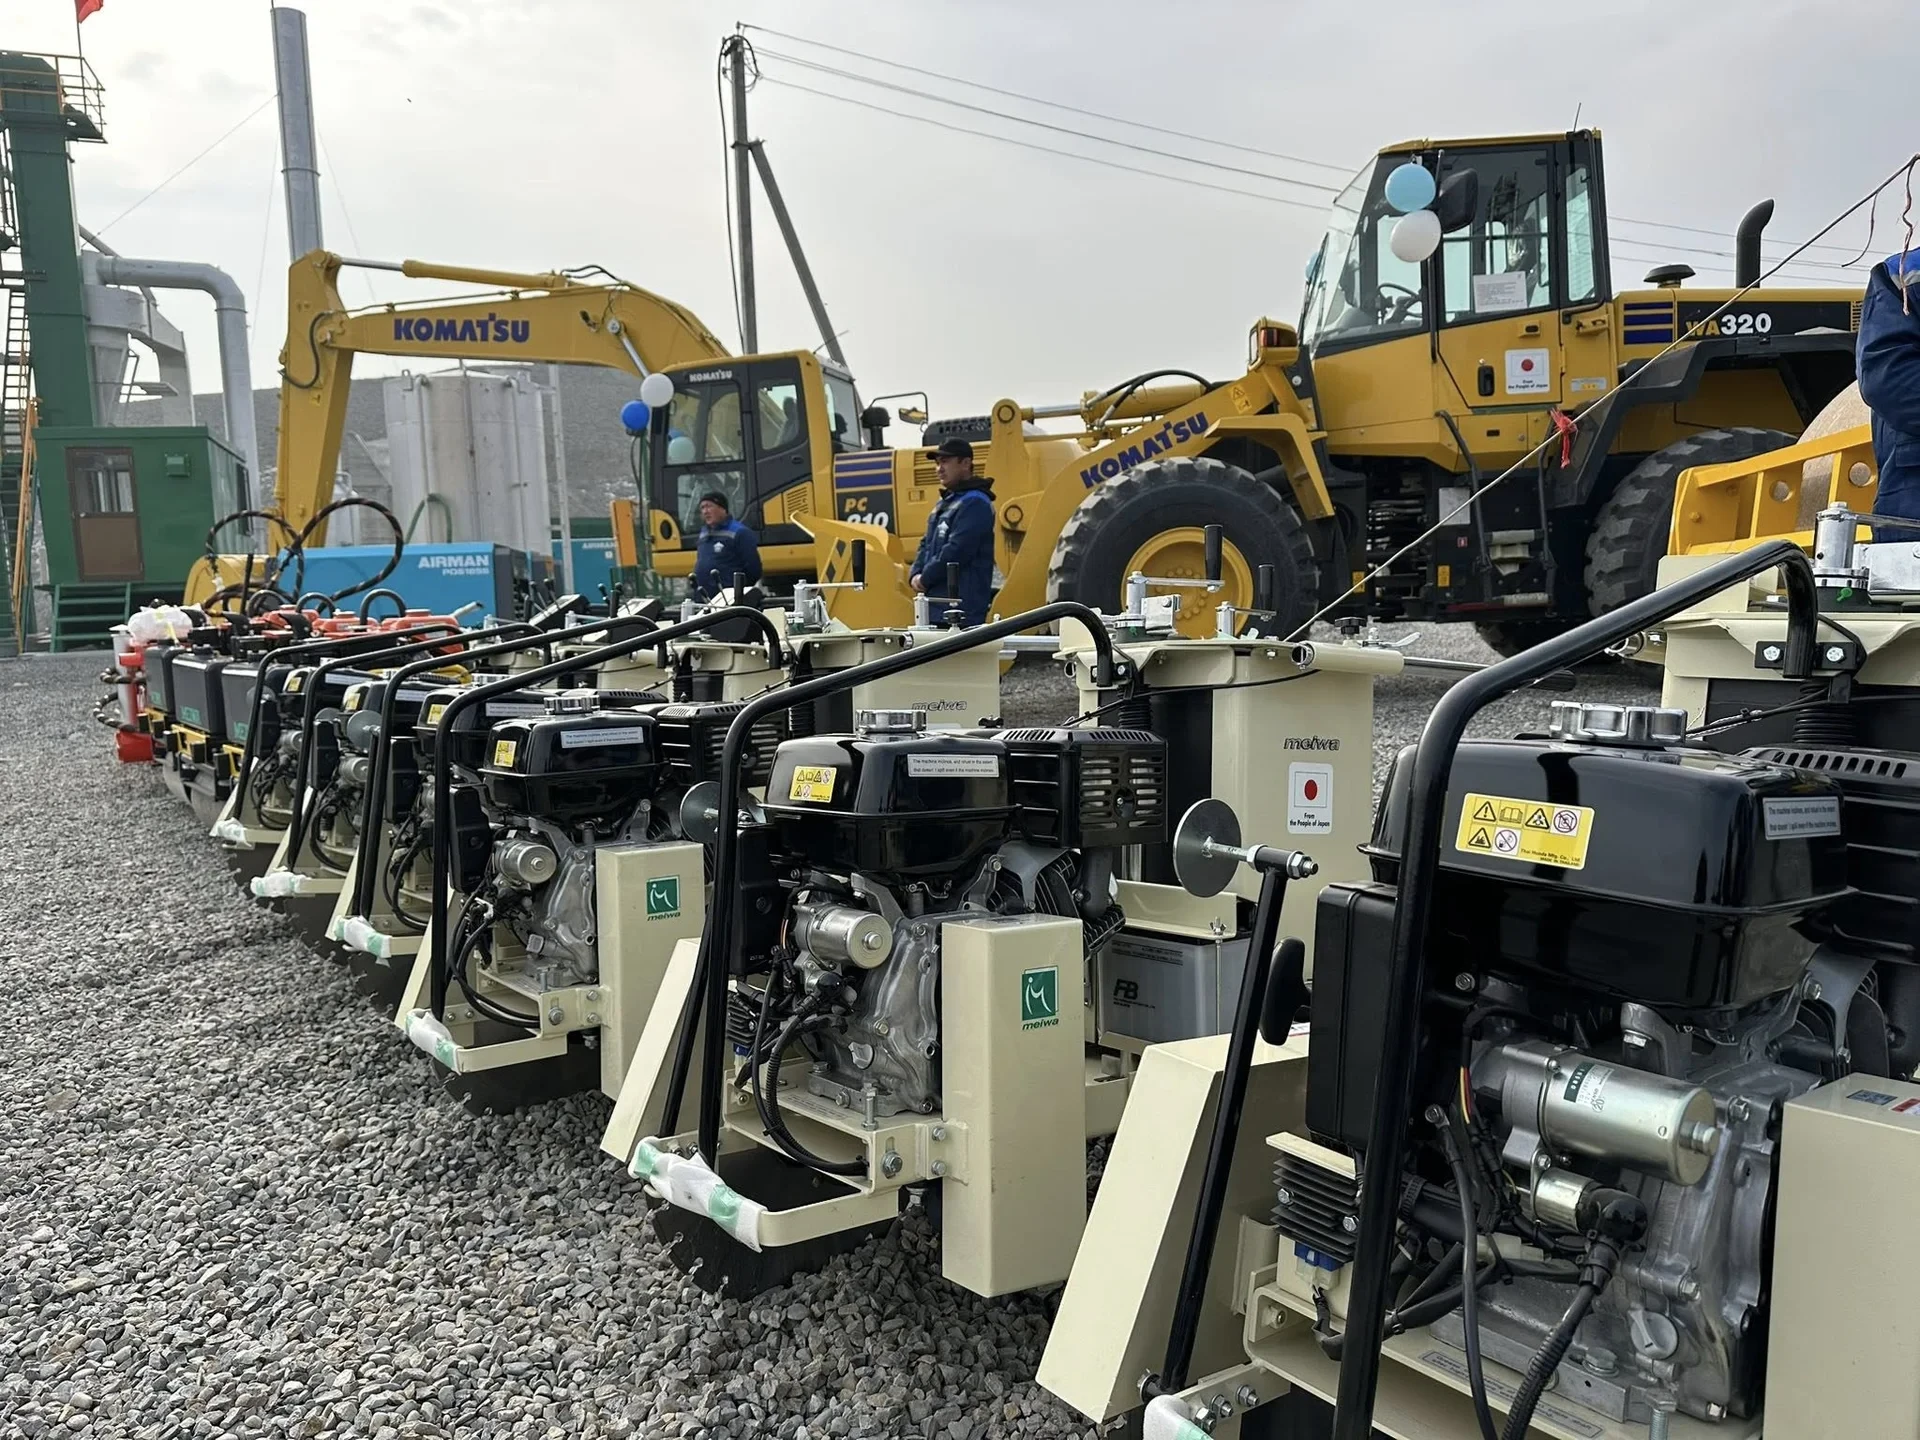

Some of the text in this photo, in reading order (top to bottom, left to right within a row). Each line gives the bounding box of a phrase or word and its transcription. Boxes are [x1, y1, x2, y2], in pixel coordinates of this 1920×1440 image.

[394, 312, 530, 343] KOMATSU
[1685, 313, 1772, 336] WA320
[689, 369, 732, 382] KOMATSU
[1080, 411, 1209, 489] KOMATSU
[844, 496, 868, 512] PC
[418, 555, 490, 569] AIRMAN
[1283, 735, 1341, 751] meiwa
[1022, 1017, 1060, 1031] meiwa
